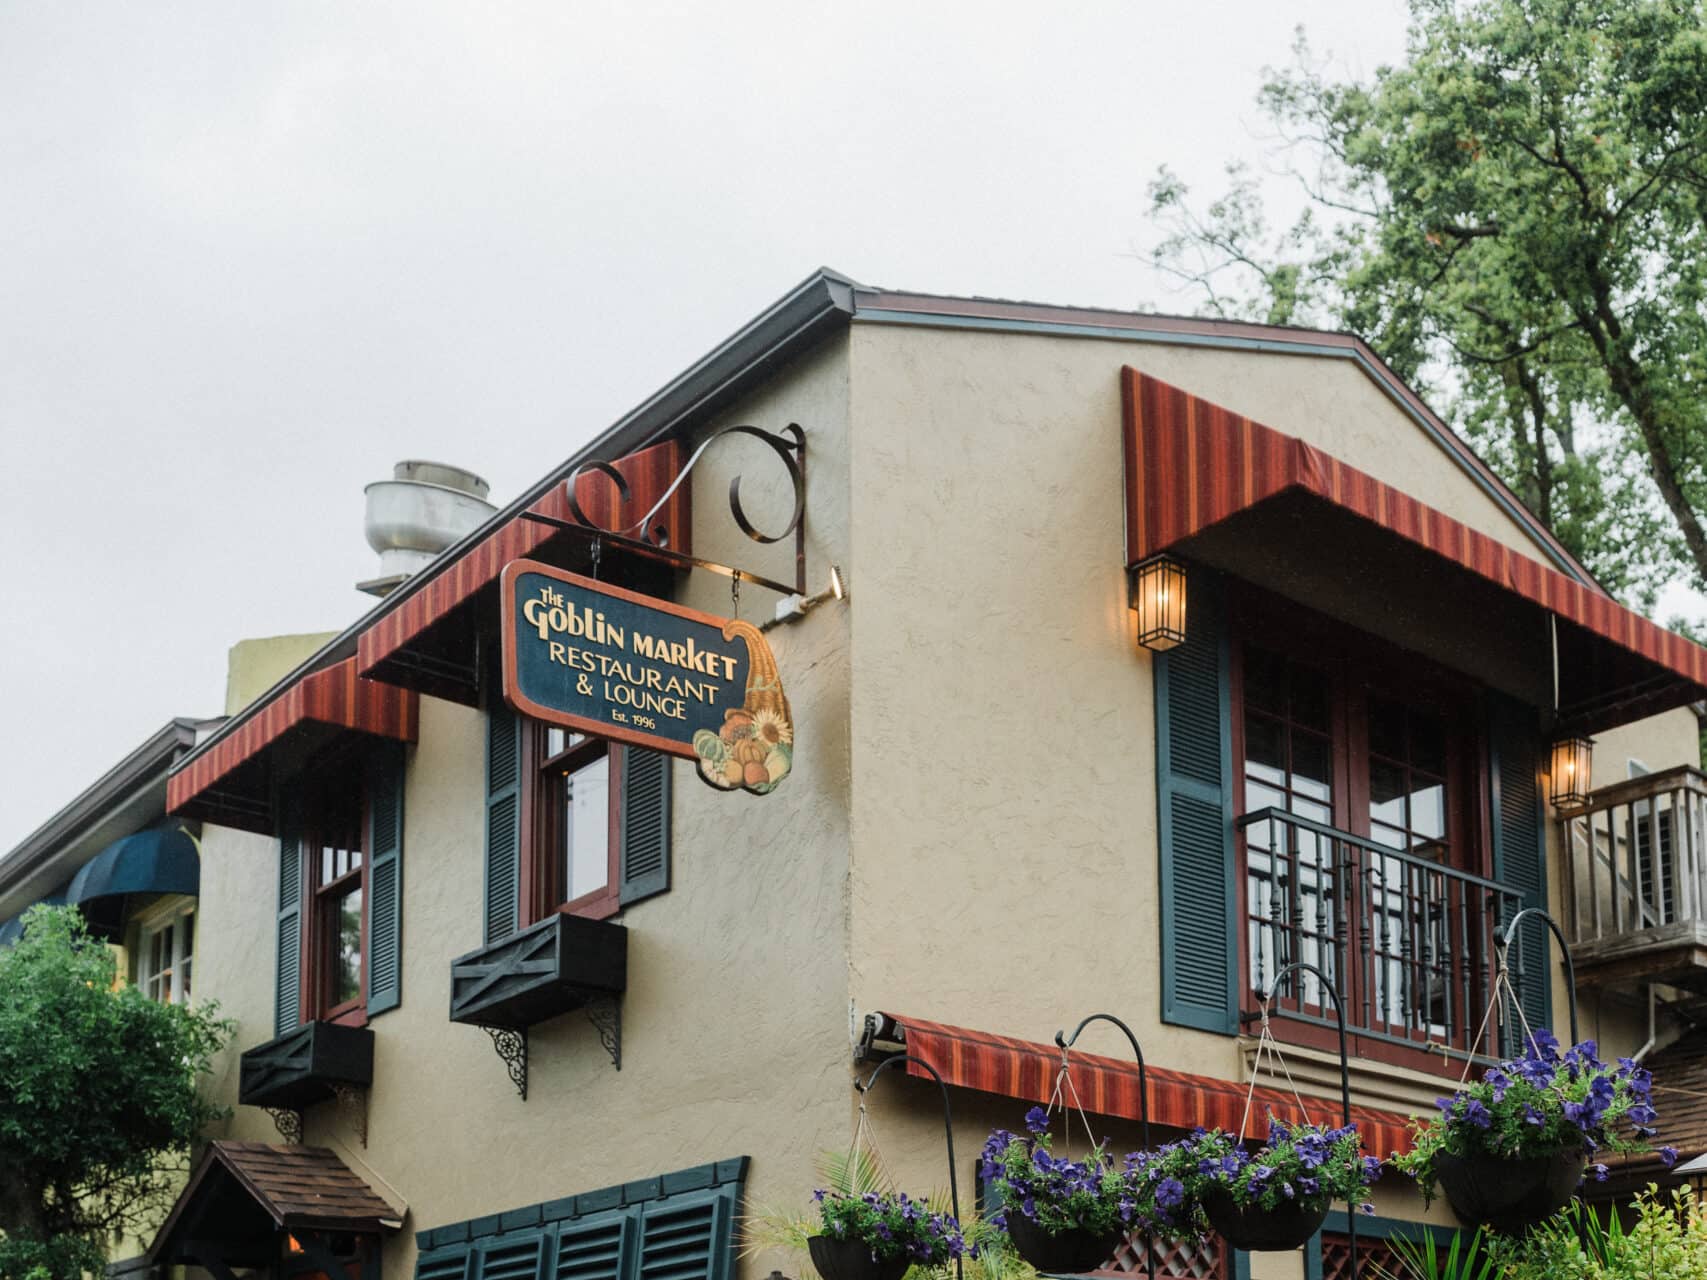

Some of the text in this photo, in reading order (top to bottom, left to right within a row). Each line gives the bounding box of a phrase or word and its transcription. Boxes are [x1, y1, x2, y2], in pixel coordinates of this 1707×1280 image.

[549, 641, 719, 705] RESTAURANT
[576, 673, 687, 720] & LOUNGE
[612, 709, 656, 730] Est. 1996
